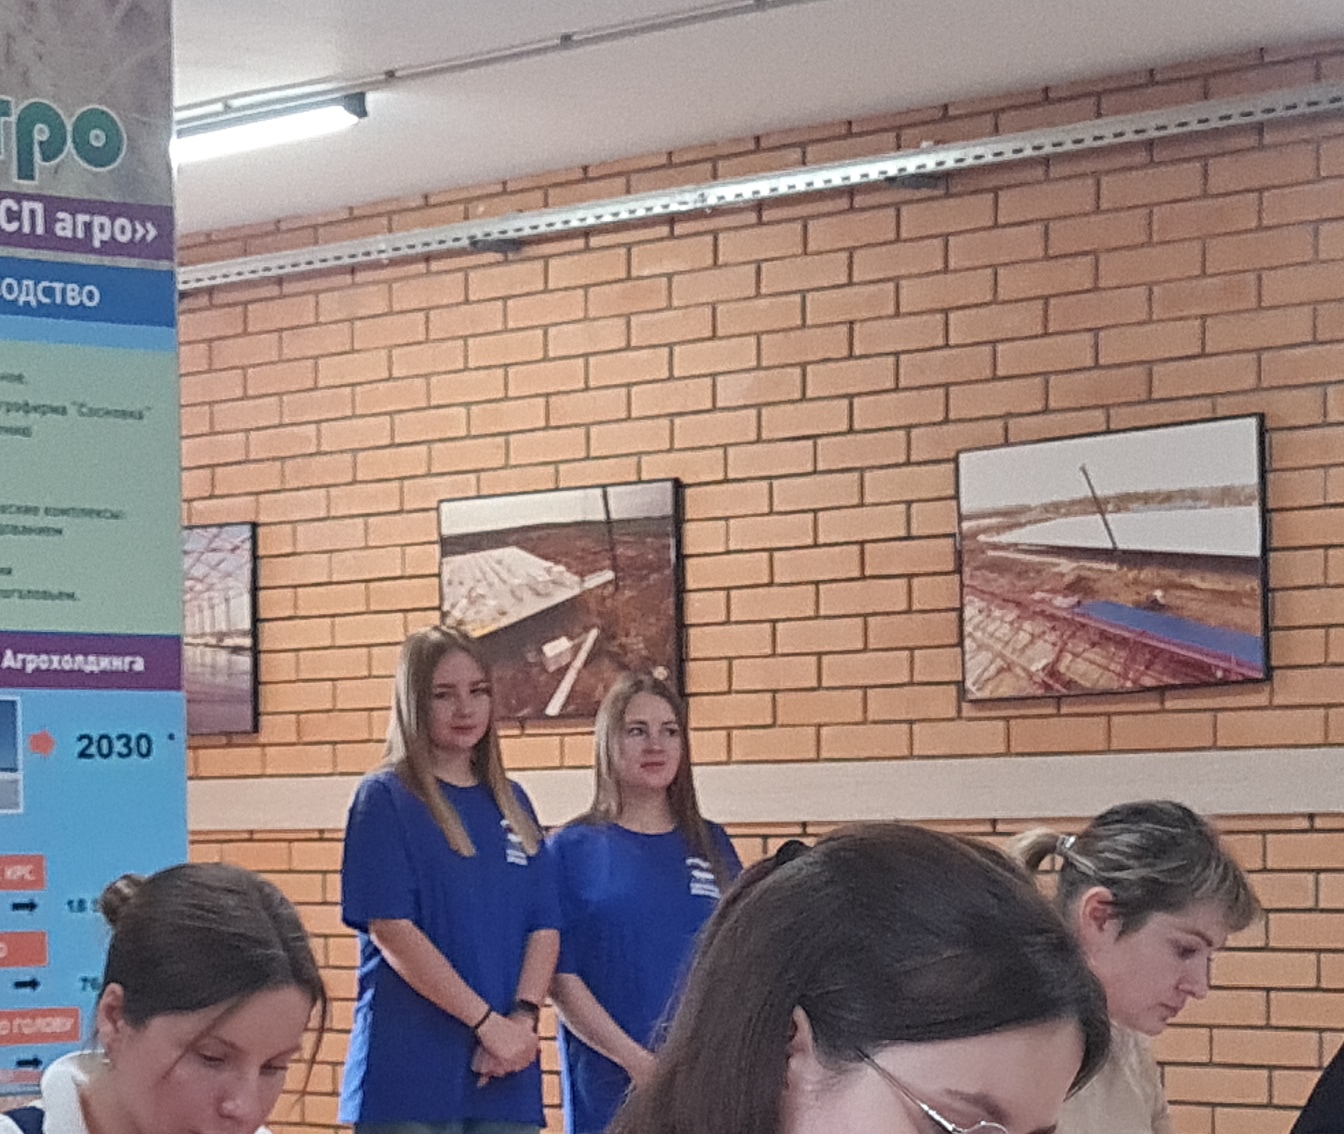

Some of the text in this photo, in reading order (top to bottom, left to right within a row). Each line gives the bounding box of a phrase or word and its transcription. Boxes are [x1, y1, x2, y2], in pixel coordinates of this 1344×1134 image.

[55, 210, 159, 248] агро»
[2, 650, 146, 676] Агрохолдинга
[76, 733, 154, 760] 2030
